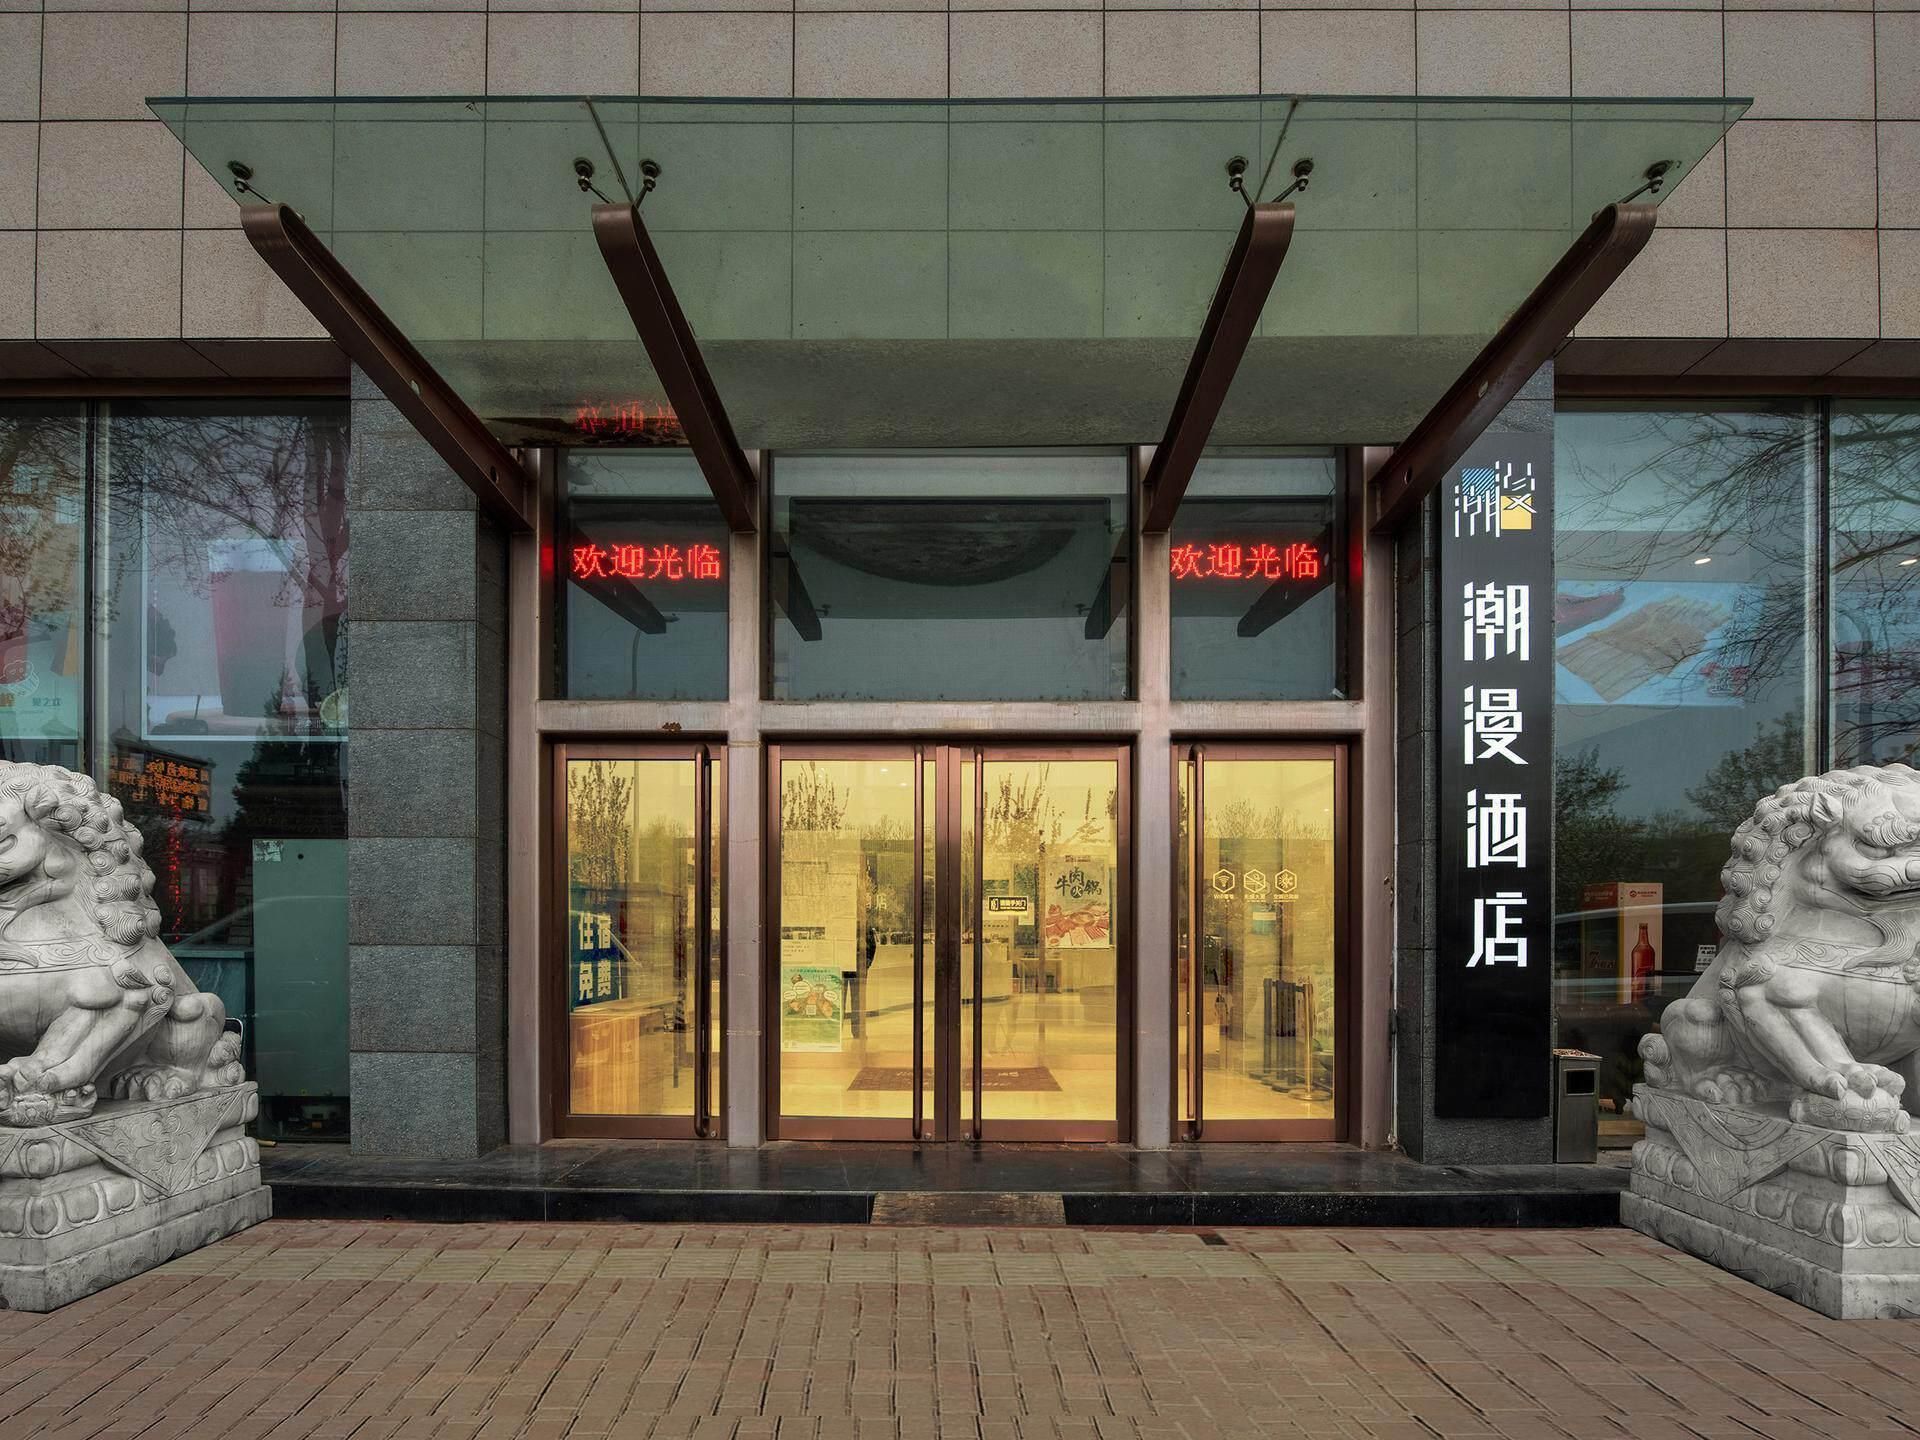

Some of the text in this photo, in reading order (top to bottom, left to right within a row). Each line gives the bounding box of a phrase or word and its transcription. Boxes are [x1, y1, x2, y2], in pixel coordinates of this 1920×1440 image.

[572, 543, 721, 580] 欢迎光临
[1170, 543, 1318, 580] 欢迎光临
[1463, 580, 1530, 968] 潮漫酒店
[1054, 866, 1103, 899] 牛肉火锅
